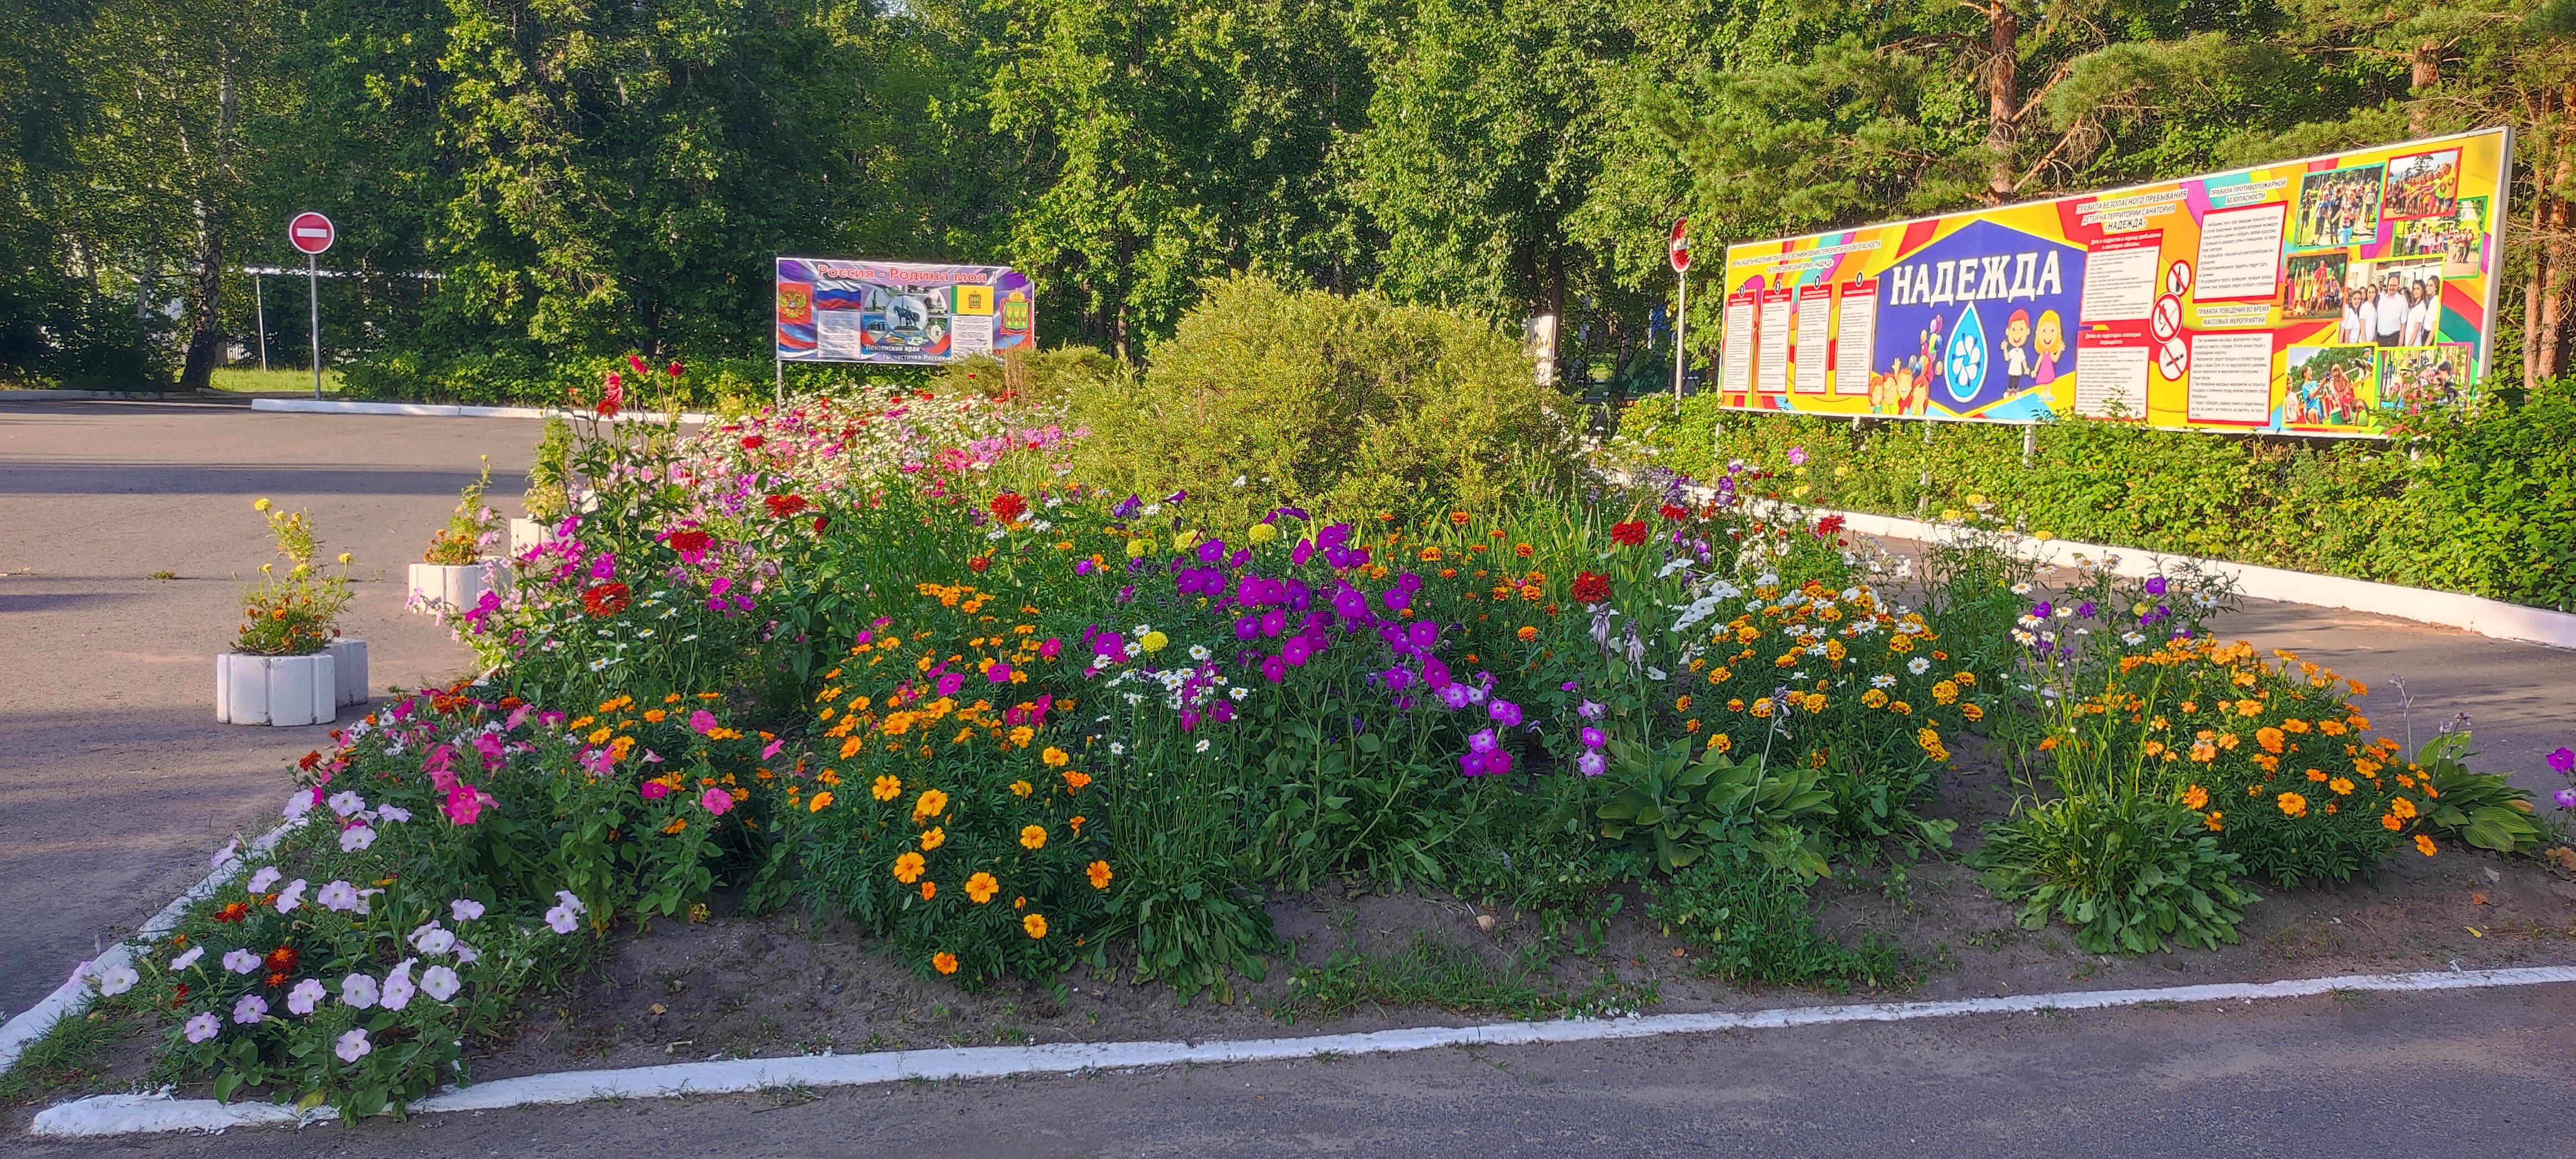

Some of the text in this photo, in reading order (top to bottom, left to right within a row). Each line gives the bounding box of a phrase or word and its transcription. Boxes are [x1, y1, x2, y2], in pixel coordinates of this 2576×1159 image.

[2210, 179, 2286, 196] ПРАВИЛА ПРОТИВОПОЖАРНОЙ
[2077, 190, 2187, 213] ПРАВИЛА БЕЗОПАСНОГО ПРЕБЫВАНИЯ
[2226, 193, 2266, 203] БЕЗОПАСНОСТИ
[2082, 214, 2098, 223] ДЕТЕЙ
[2108, 209, 2141, 220] ТЕРРИТОРИИ
[2142, 204, 2175, 215] САНАТОРИЯ
[2105, 218, 2146, 231] «НАДЕЖДА»
[818, 264, 875, 279] Россия
[889, 267, 949, 283] Родина
[954, 272, 987, 283] моя
[1889, 250, 2062, 309] НАДЕЖДА
[2230, 316, 2265, 324] МЕРОПРИЯТИЙ
[904, 345, 920, 353] край
